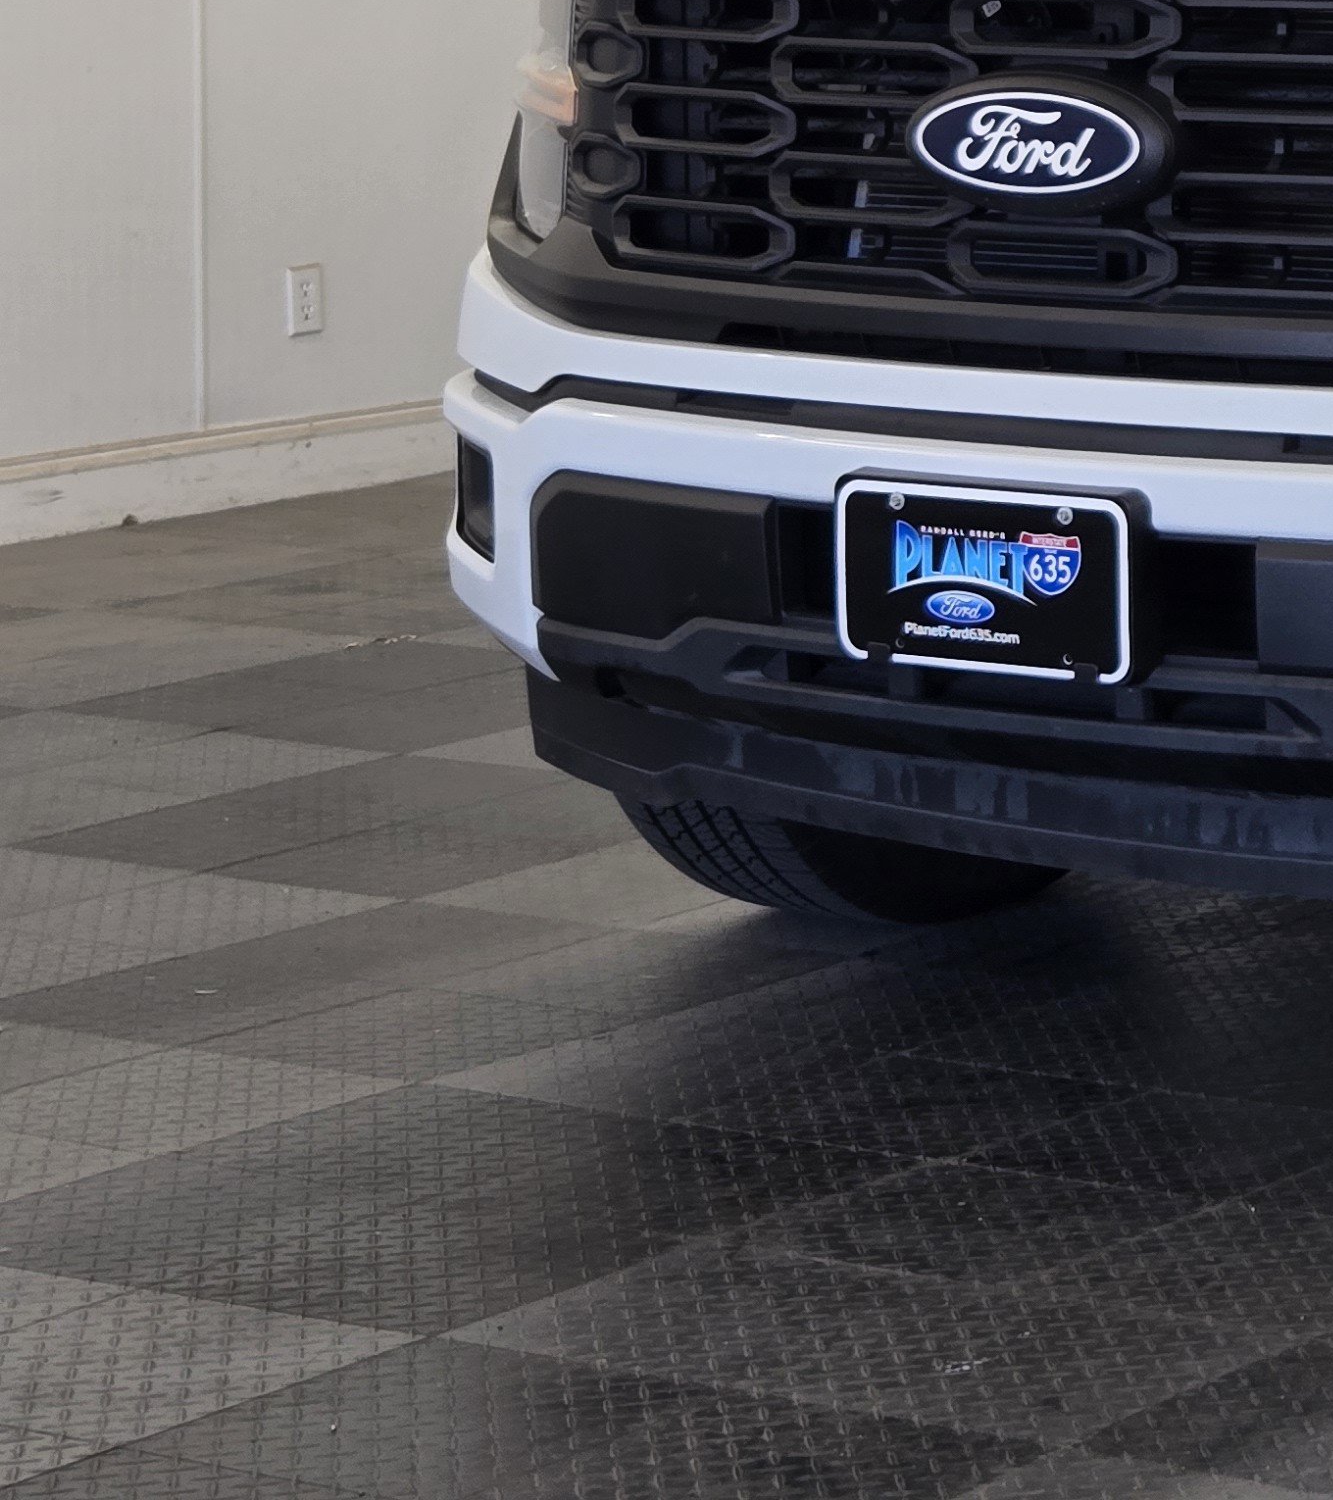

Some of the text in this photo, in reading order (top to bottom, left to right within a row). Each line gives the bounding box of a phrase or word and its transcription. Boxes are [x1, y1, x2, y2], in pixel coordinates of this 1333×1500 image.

[957, 104, 1096, 178] Ford
[895, 519, 1072, 595] PLANET 635
[939, 592, 984, 620] Ford
[903, 621, 1021, 645] PlanetFord635.com
